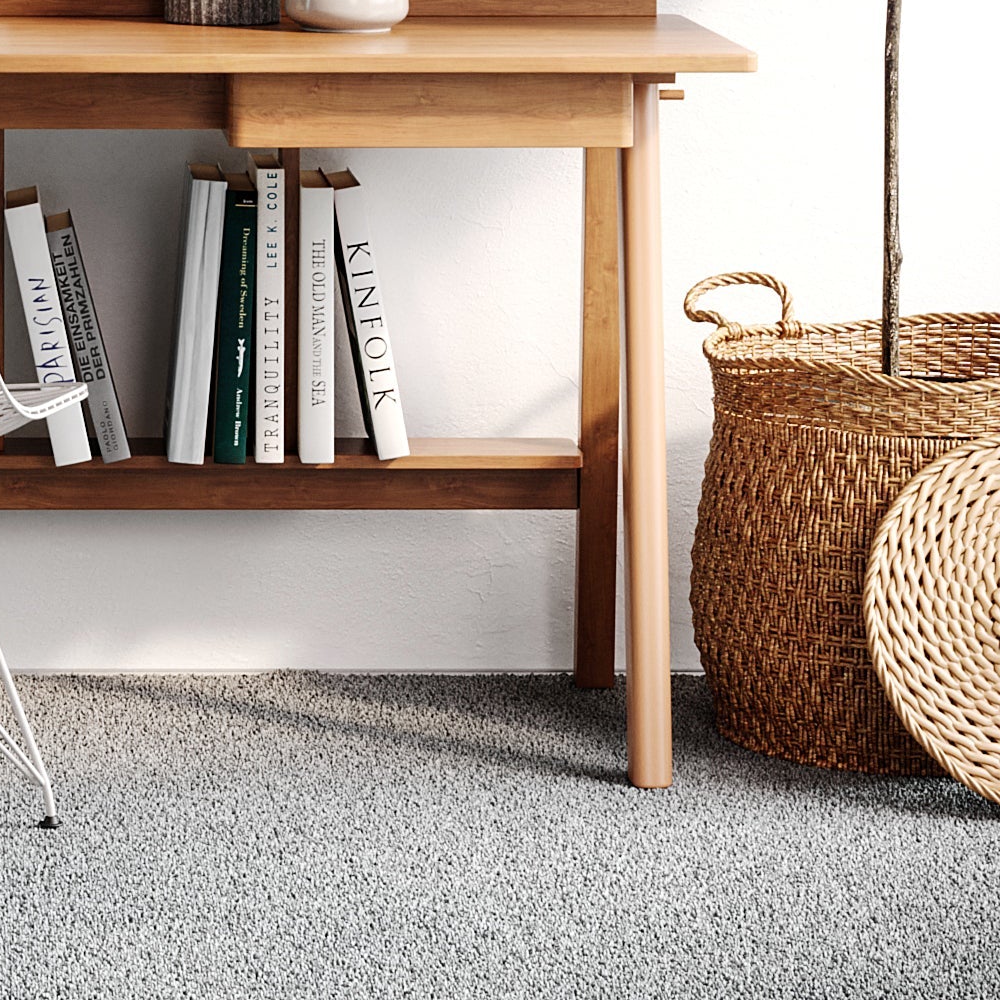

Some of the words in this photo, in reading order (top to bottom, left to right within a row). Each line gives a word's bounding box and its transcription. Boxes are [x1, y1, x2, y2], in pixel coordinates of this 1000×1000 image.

[266, 172, 278, 210] COLE
[266, 220, 278, 233] K.
[240, 227, 251, 275] Dreaming
[266, 242, 277, 268] LEE
[312, 239, 326, 268] THE
[61, 234, 97, 342] PRIMZAHLEN
[240, 277, 248, 288] of
[312, 271, 326, 302] OLD
[52, 252, 86, 352] EINSAMKEIT
[238, 290, 248, 328] Sweden
[27, 278, 75, 384] PARISIAN
[312, 305, 326, 336] MAN
[347, 241, 397, 410] KINFOLK
[312, 337, 323, 356] AND
[79, 354, 94, 383] DIE
[91, 345, 106, 380] DER
[264, 297, 281, 452] TRANQUILITY
[312, 357, 323, 376] THE
[235, 387, 243, 418] Andrew
[312, 380, 326, 407] SEA
[100, 421, 112, 453] PAOLO
[102, 400, 119, 451] GIORDANO
[233, 420, 242, 446] Brown
